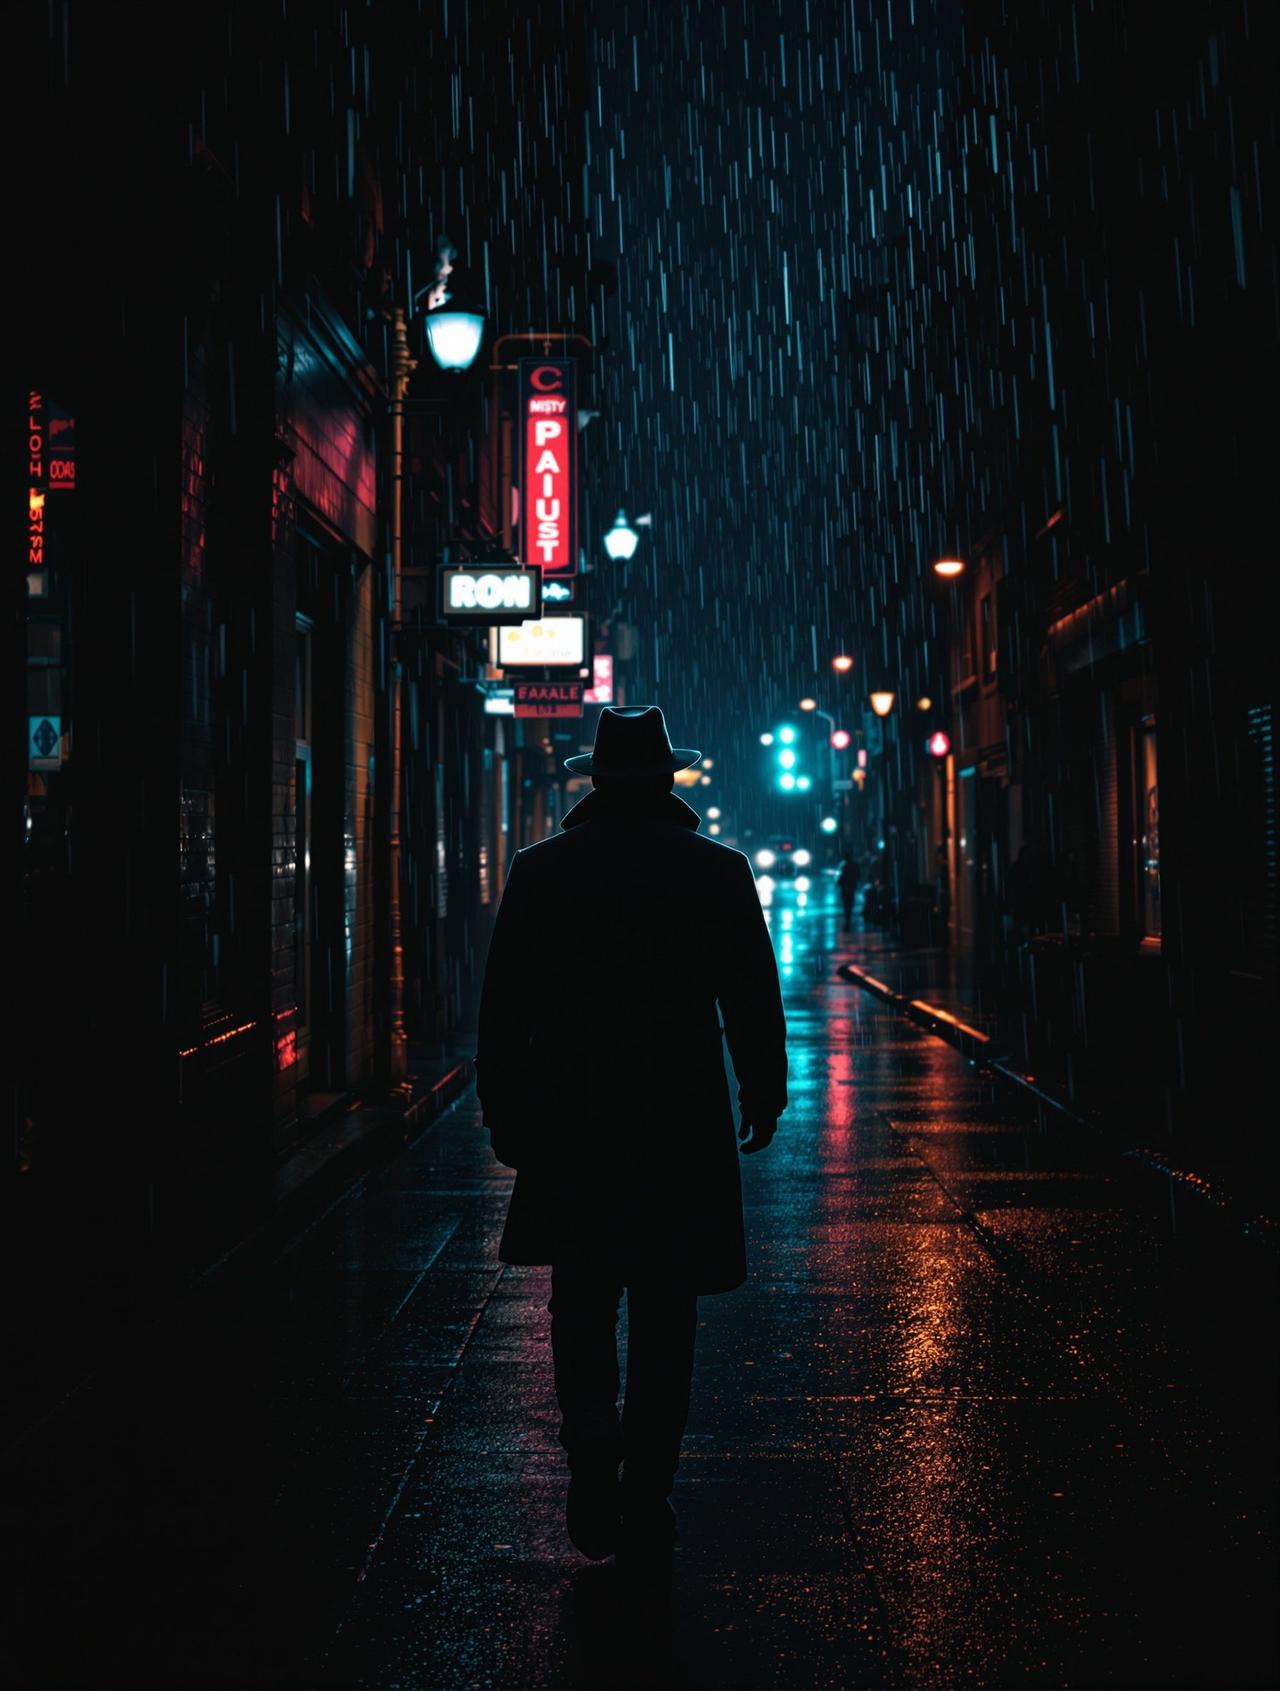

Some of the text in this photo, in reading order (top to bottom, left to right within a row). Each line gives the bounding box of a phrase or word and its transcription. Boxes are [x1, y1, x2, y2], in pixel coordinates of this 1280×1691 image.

[531, 366, 563, 391] C
[536, 420, 561, 562] PAIUST
[450, 574, 530, 608] RON
